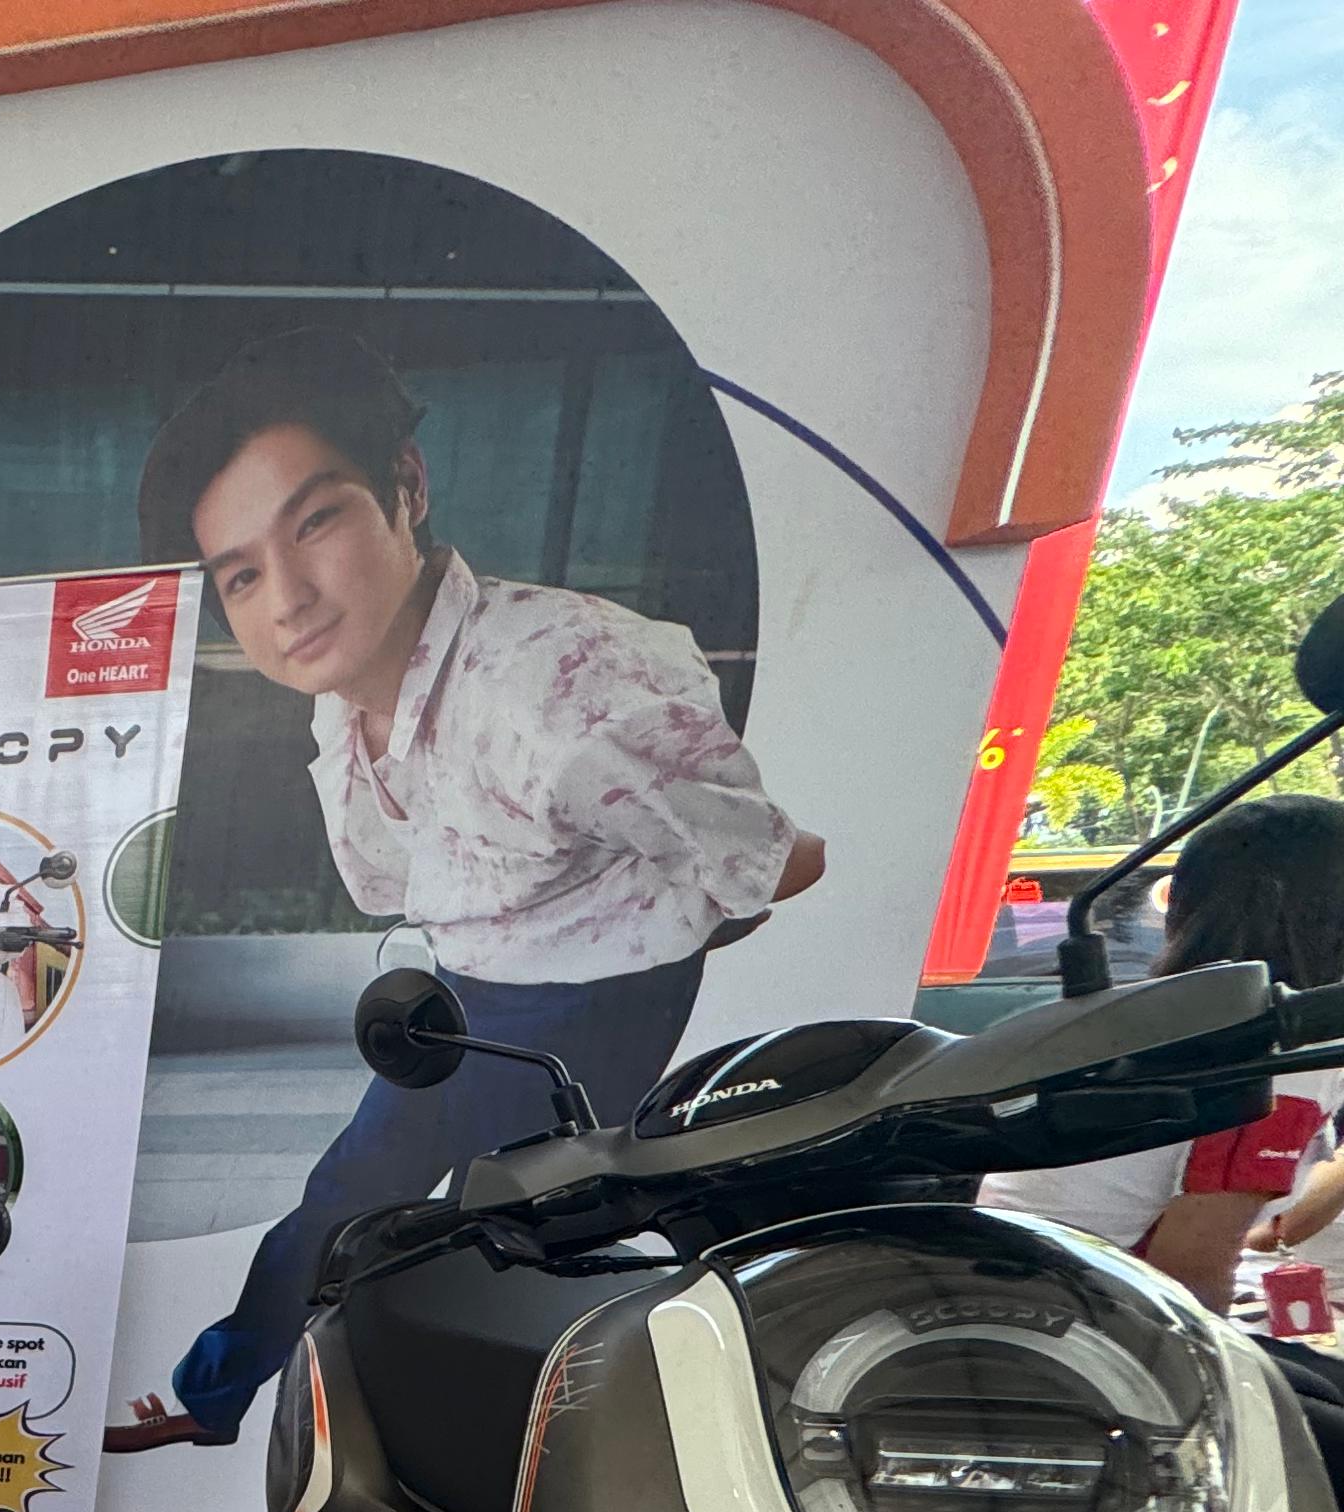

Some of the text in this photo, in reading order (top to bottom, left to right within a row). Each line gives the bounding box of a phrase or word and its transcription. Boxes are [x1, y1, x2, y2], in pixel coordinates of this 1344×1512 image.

[69, 637, 151, 653] HONDA
[67, 664, 149, 684] One HEART.
[669, 1079, 783, 1118] HONDA
[7, 1337, 45, 1353] spot
